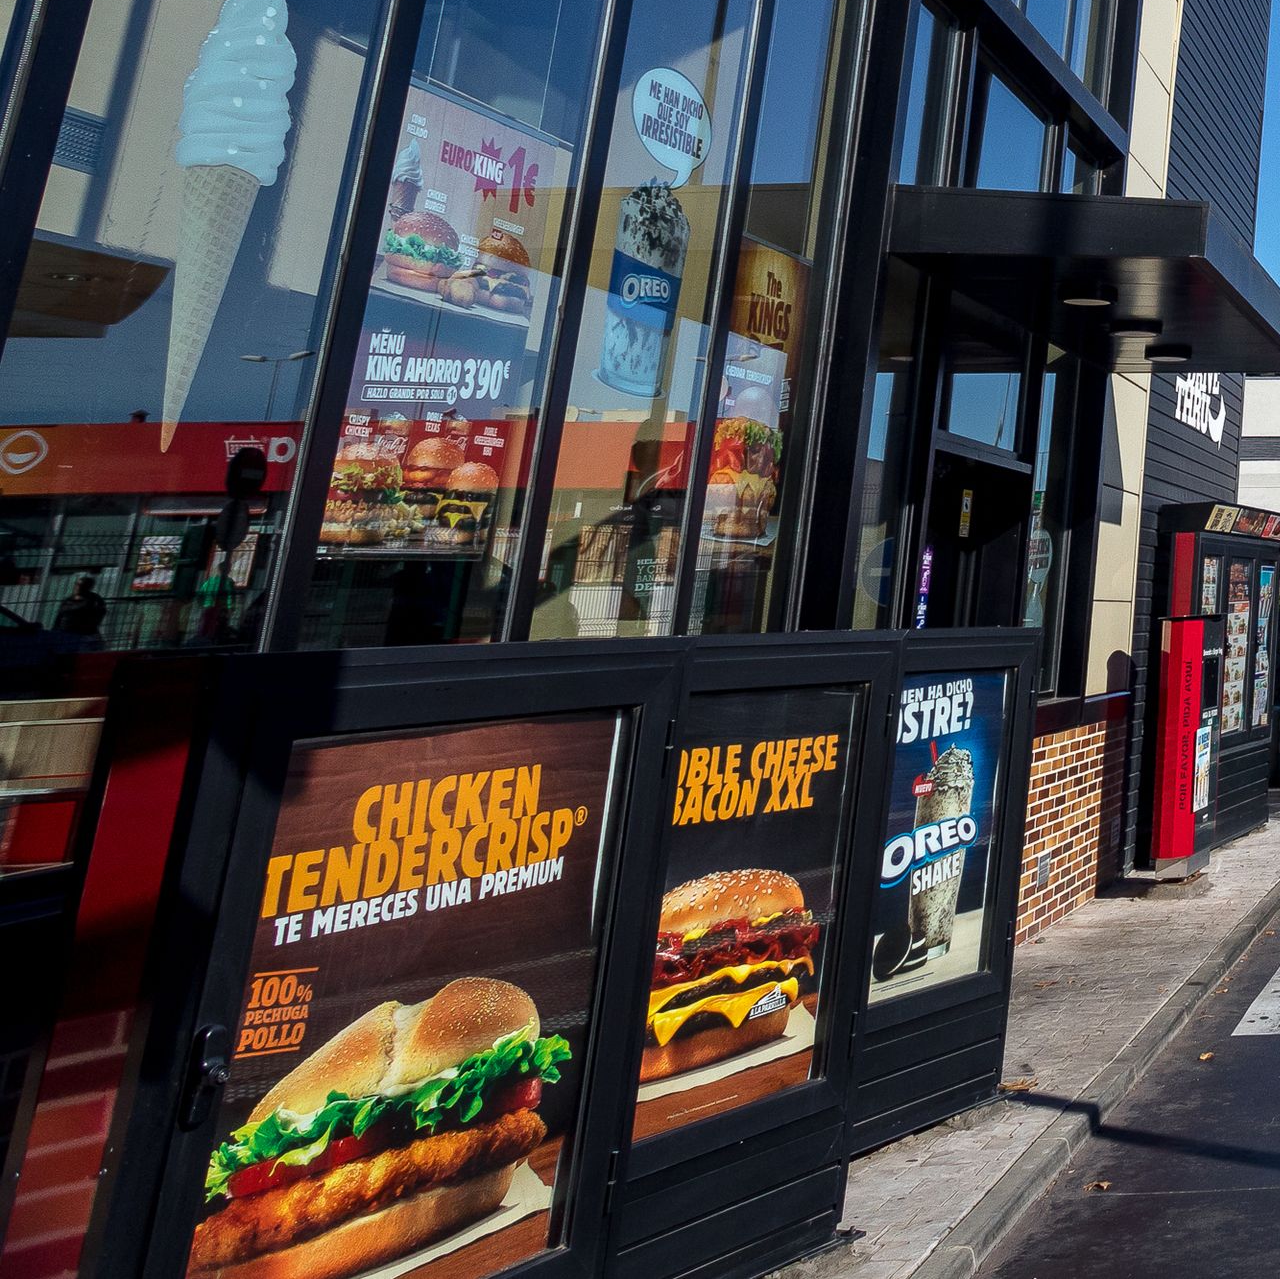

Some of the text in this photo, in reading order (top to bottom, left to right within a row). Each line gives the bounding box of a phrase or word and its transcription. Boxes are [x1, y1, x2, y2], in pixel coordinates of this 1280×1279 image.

[649, 79, 703, 120] ME HAN DICHO
[657, 102, 691, 131] QUE SOY
[641, 113, 703, 160] IRRESISTIBLE
[620, 273, 670, 305] OREO
[767, 271, 783, 299] The
[747, 292, 791, 342] KINGS
[365, 355, 402, 382] KING
[404, 356, 462, 384] AHORRO
[1175, 375, 1211, 434] THRU
[927, 684, 944, 700] HA
[946, 678, 973, 696] DICHO
[751, 734, 839, 779] CHEESE
[353, 764, 543, 844] CHICKEN
[763, 770, 814, 814] XXL
[1179, 784, 1188, 811] POR
[882, 815, 977, 879] OREO
[912, 853, 960, 896] SHAKE
[274, 856, 565, 946] TE MERECES UNA PREMIUM
[249, 975, 313, 1010] 100%
[244, 1003, 309, 1026] PECHUGA
[237, 1022, 306, 1052] POLLO
